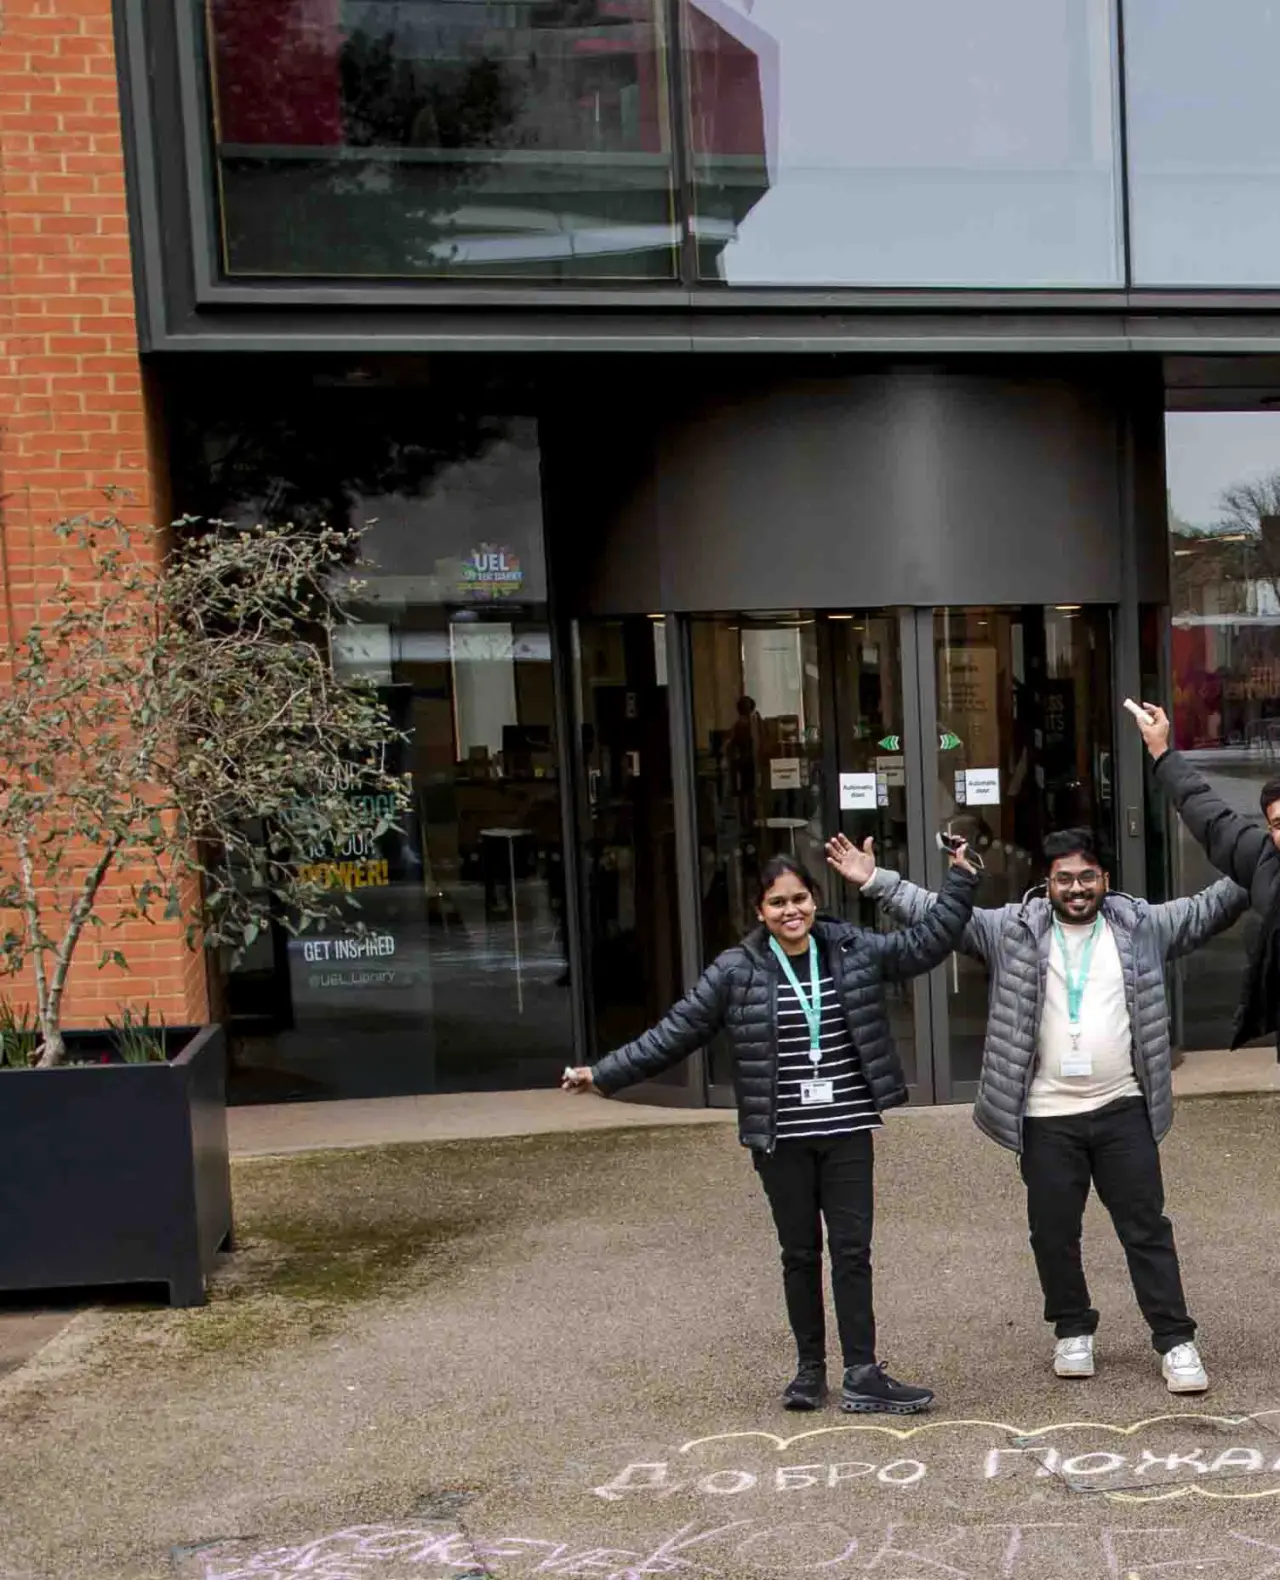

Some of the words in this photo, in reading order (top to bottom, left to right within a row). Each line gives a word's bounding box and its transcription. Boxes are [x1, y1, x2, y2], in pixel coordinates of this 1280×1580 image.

[475, 552, 510, 571] UEL
[303, 940, 331, 962] GET
[334, 935, 396, 961] INSPIRED
[594, 1459, 927, 1500] ДОБРО
